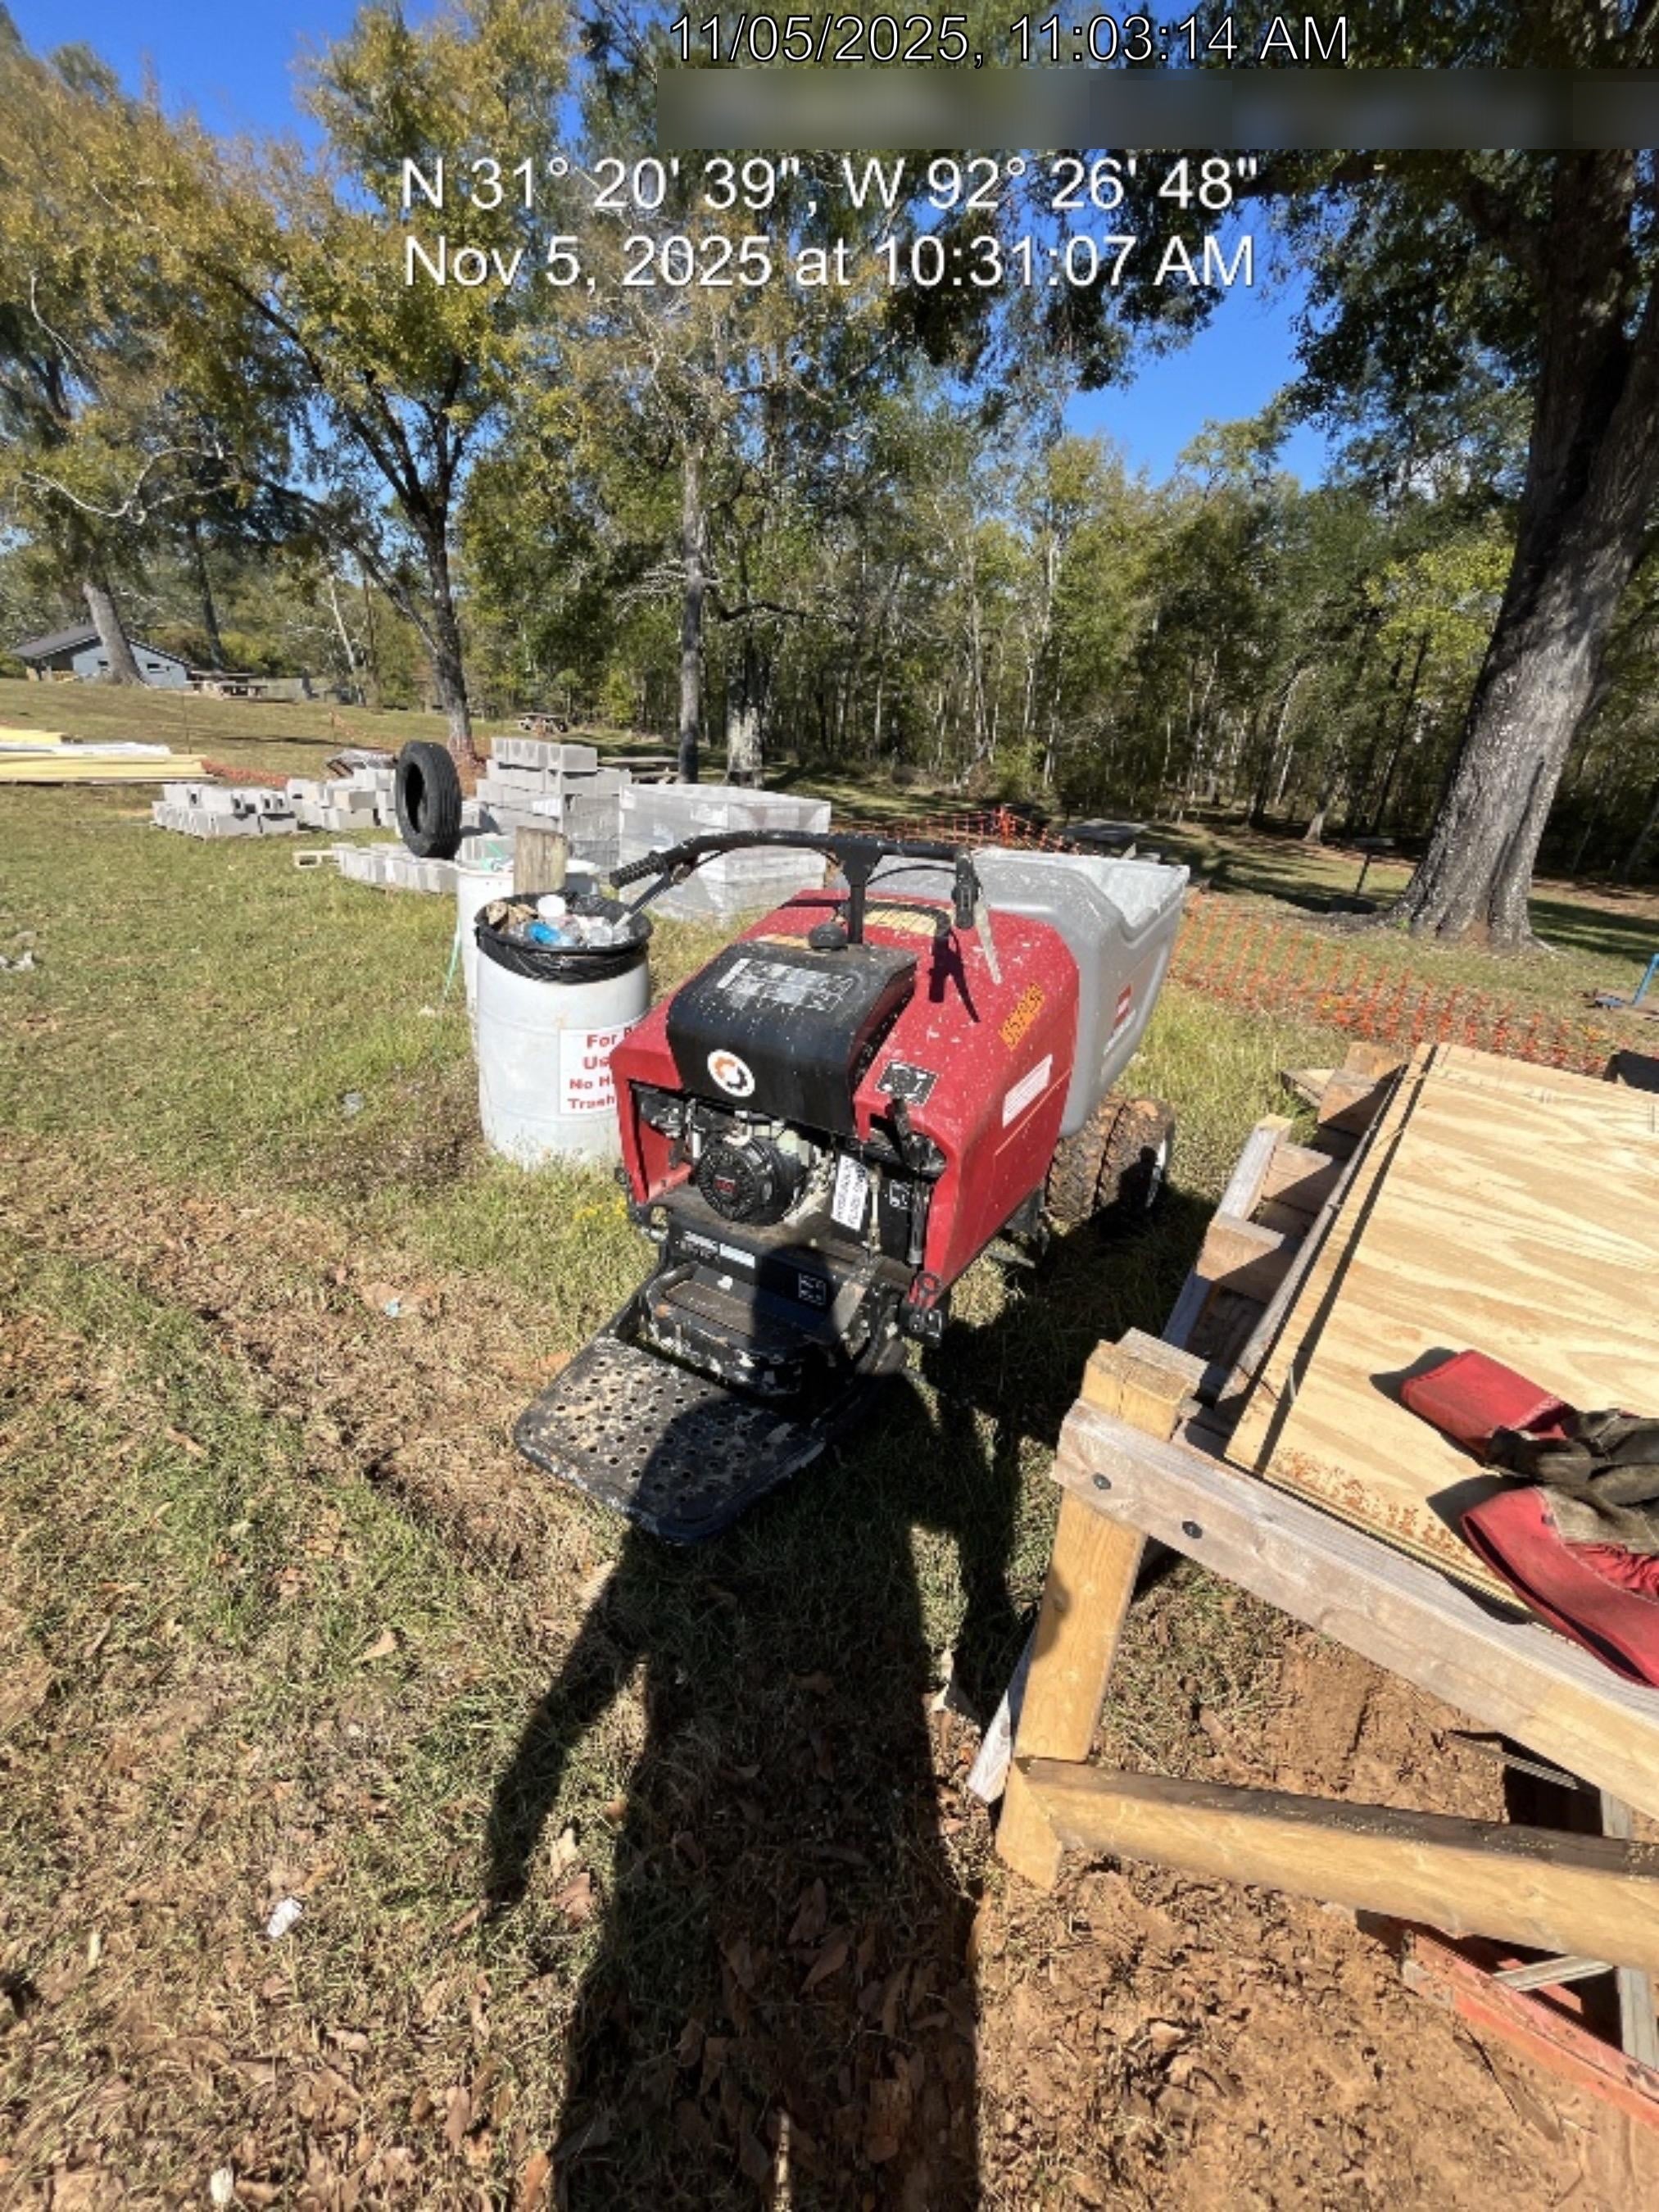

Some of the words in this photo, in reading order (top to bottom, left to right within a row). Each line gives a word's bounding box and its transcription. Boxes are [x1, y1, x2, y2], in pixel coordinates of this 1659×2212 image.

[587, 1035, 617, 1049] For
[582, 1055, 610, 1070] Us
[569, 1078, 593, 1090] No
